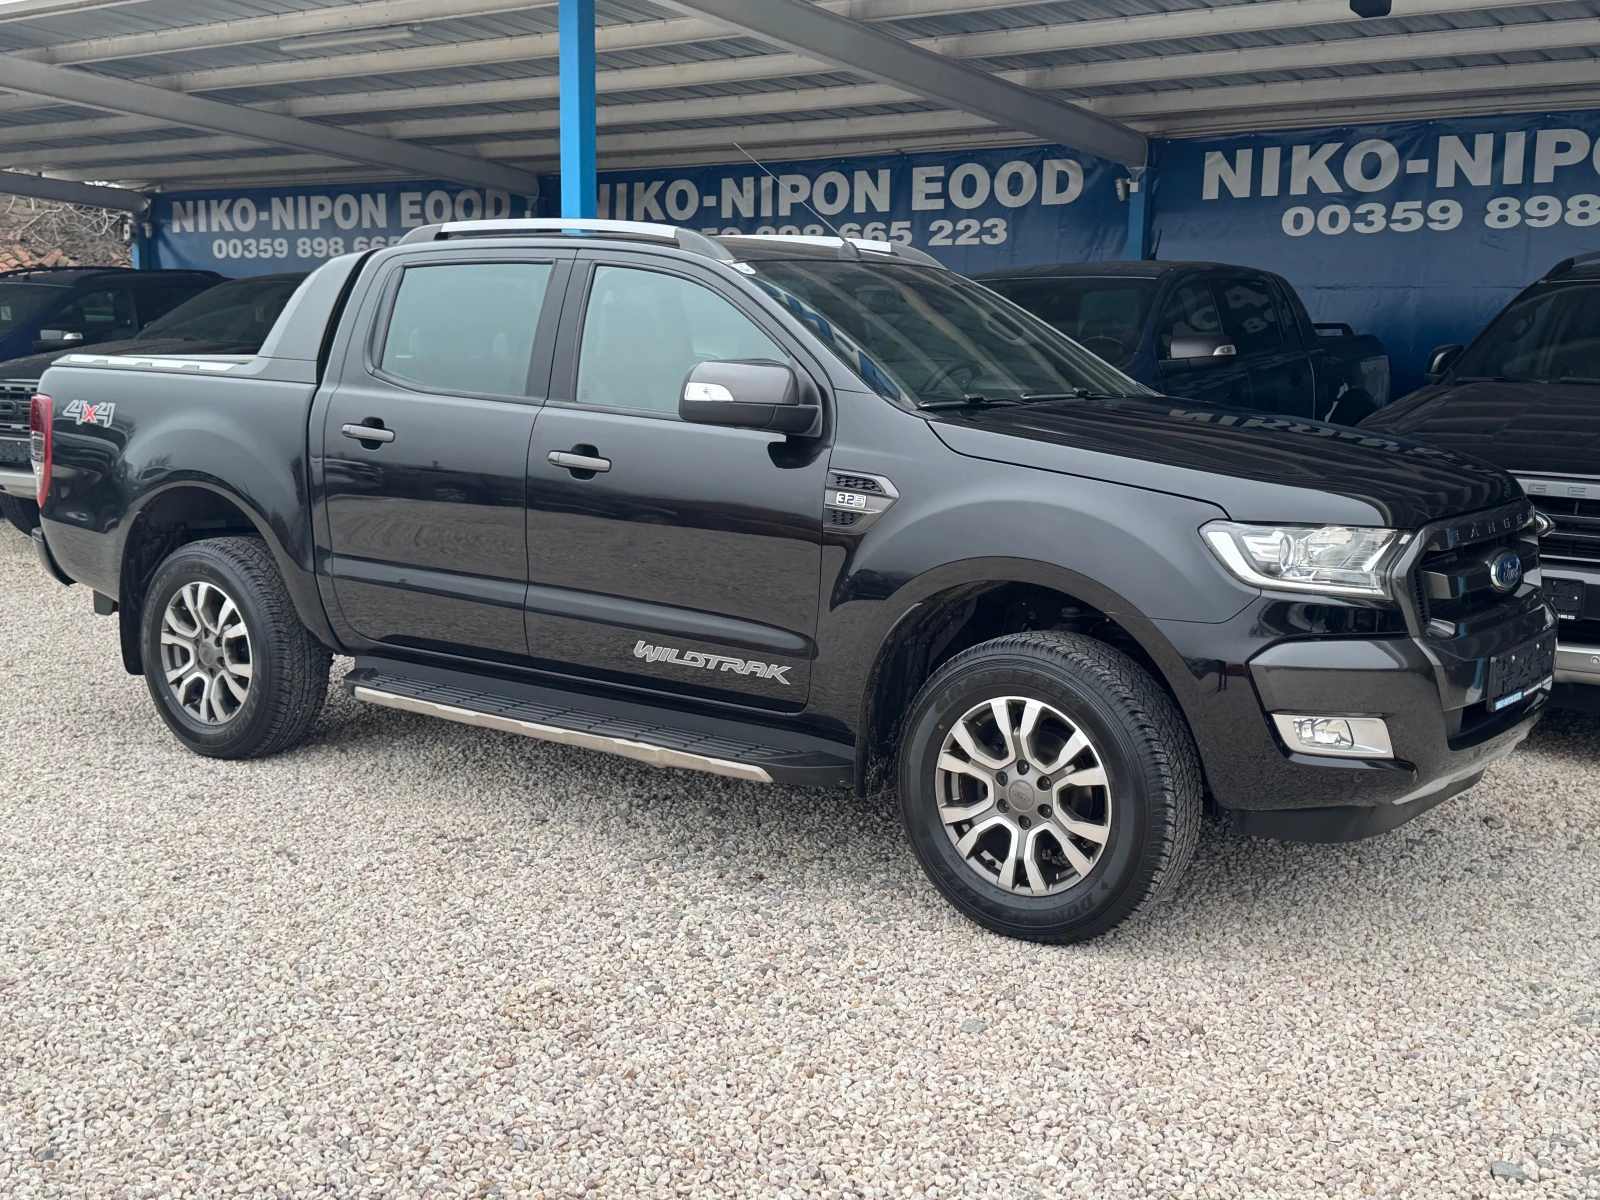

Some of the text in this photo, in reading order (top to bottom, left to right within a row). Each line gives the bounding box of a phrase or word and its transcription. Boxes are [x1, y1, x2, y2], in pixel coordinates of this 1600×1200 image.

[911, 159, 1084, 210] EOOD
[1203, 128, 1600, 200] NIKO-NIP
[172, 189, 511, 233] NIKO-NIPON EOOD
[838, 221, 913, 246] 665
[928, 217, 1008, 246] 223
[1282, 193, 1600, 237] 00359 898
[212, 237, 289, 259] 00359
[296, 236, 345, 258] 898
[633, 640, 793, 685] WILDTRAK
